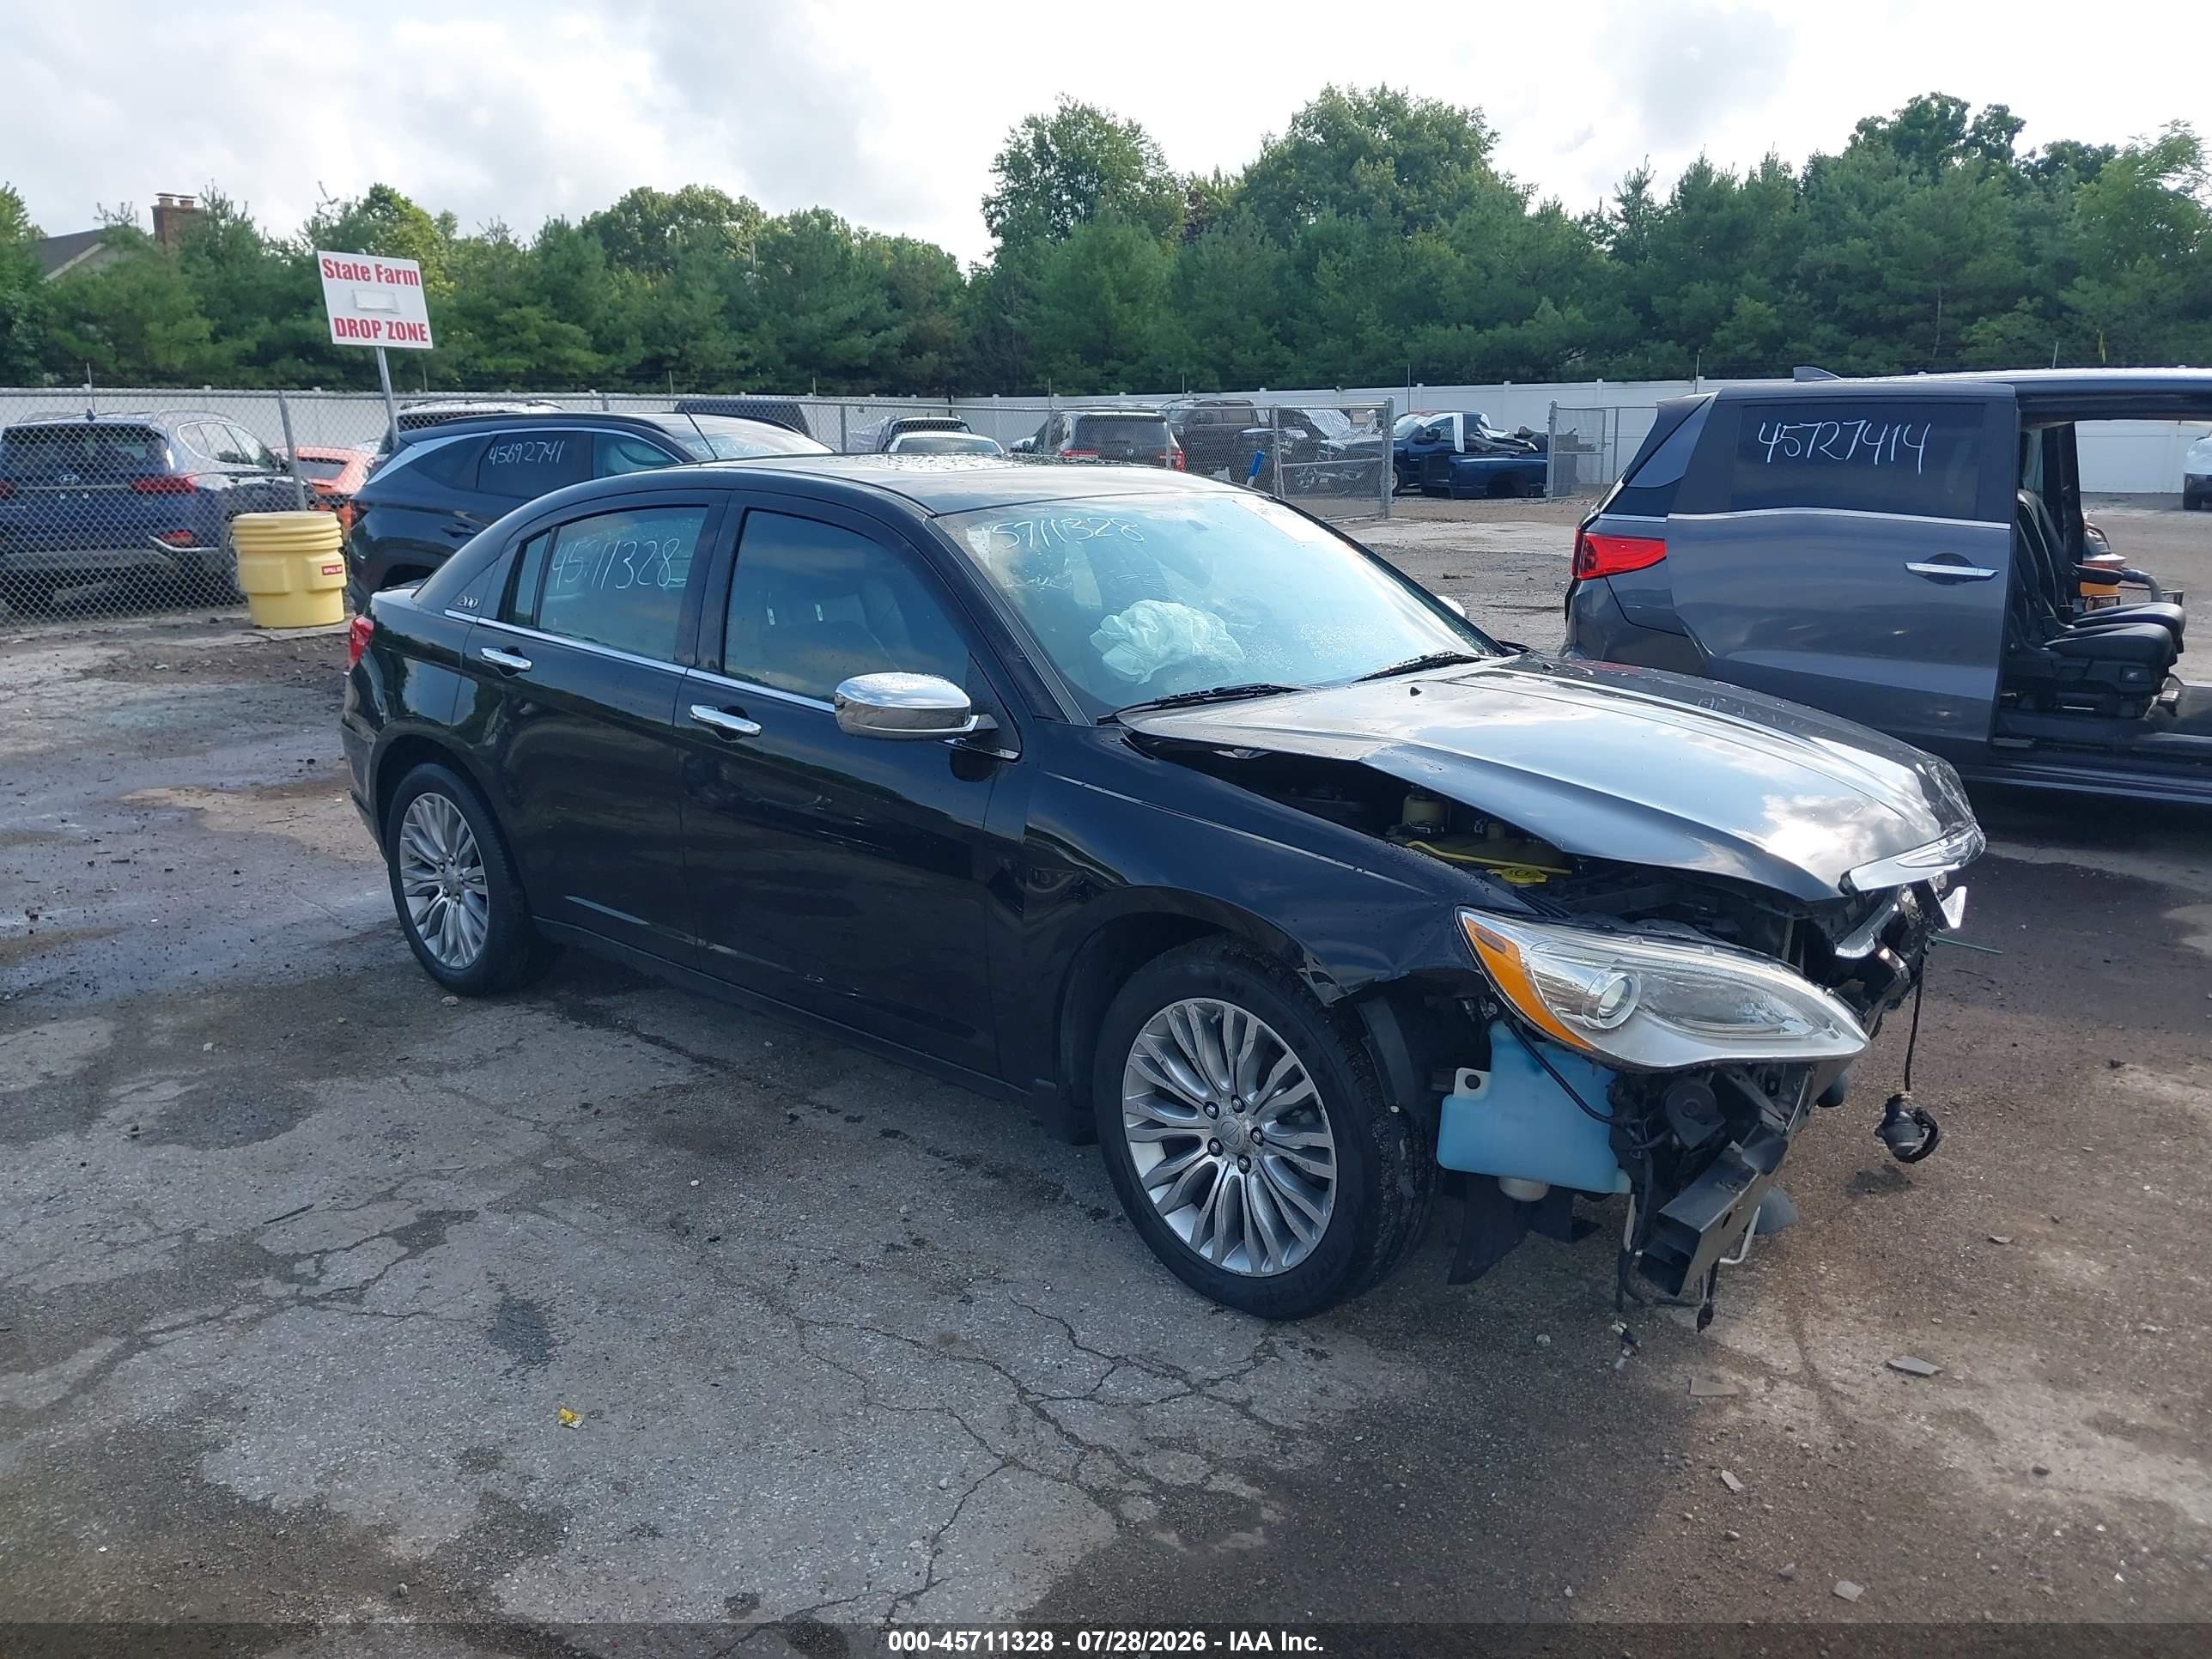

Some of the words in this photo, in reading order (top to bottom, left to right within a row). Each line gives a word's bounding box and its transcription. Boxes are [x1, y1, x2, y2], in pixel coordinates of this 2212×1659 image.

[322, 258, 371, 282] State
[374, 264, 419, 286] Farm
[334, 318, 381, 339] DROP
[386, 321, 428, 342] ZONE
[489, 441, 565, 465] 45692741
[1758, 419, 1931, 475] 45727414
